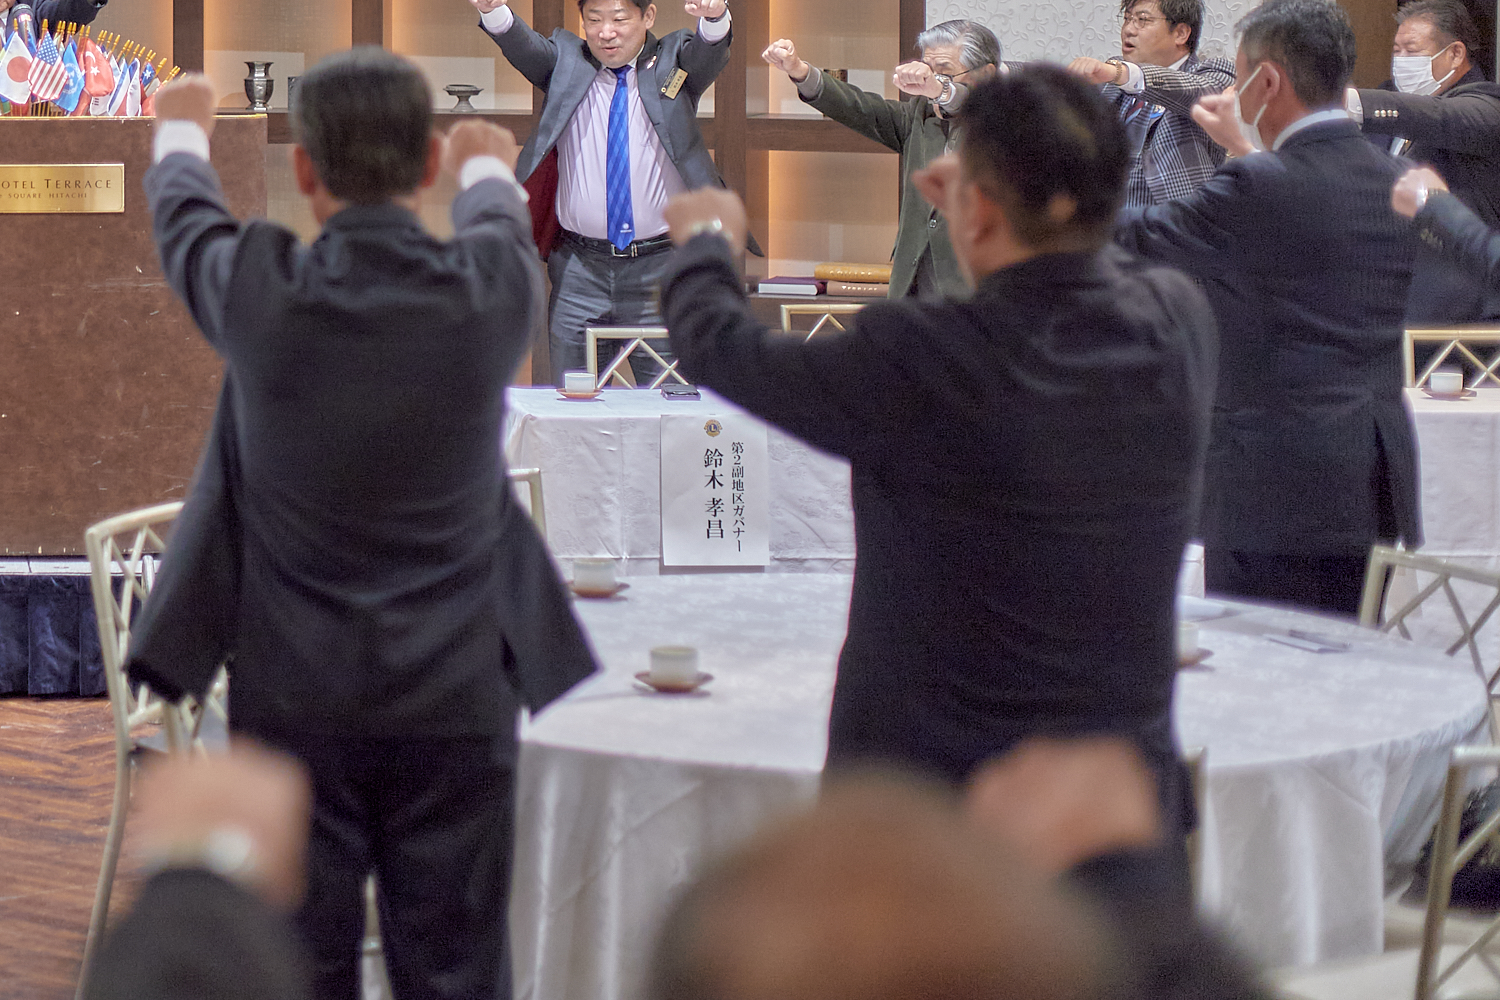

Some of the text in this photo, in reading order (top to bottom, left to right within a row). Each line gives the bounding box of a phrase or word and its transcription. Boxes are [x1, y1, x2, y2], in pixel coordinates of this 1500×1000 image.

[44, 178, 111, 189] TERRACE
[704, 448, 725, 540] 鈴木 孝昌
[731, 441, 746, 552] 第2副地区ガバナー
